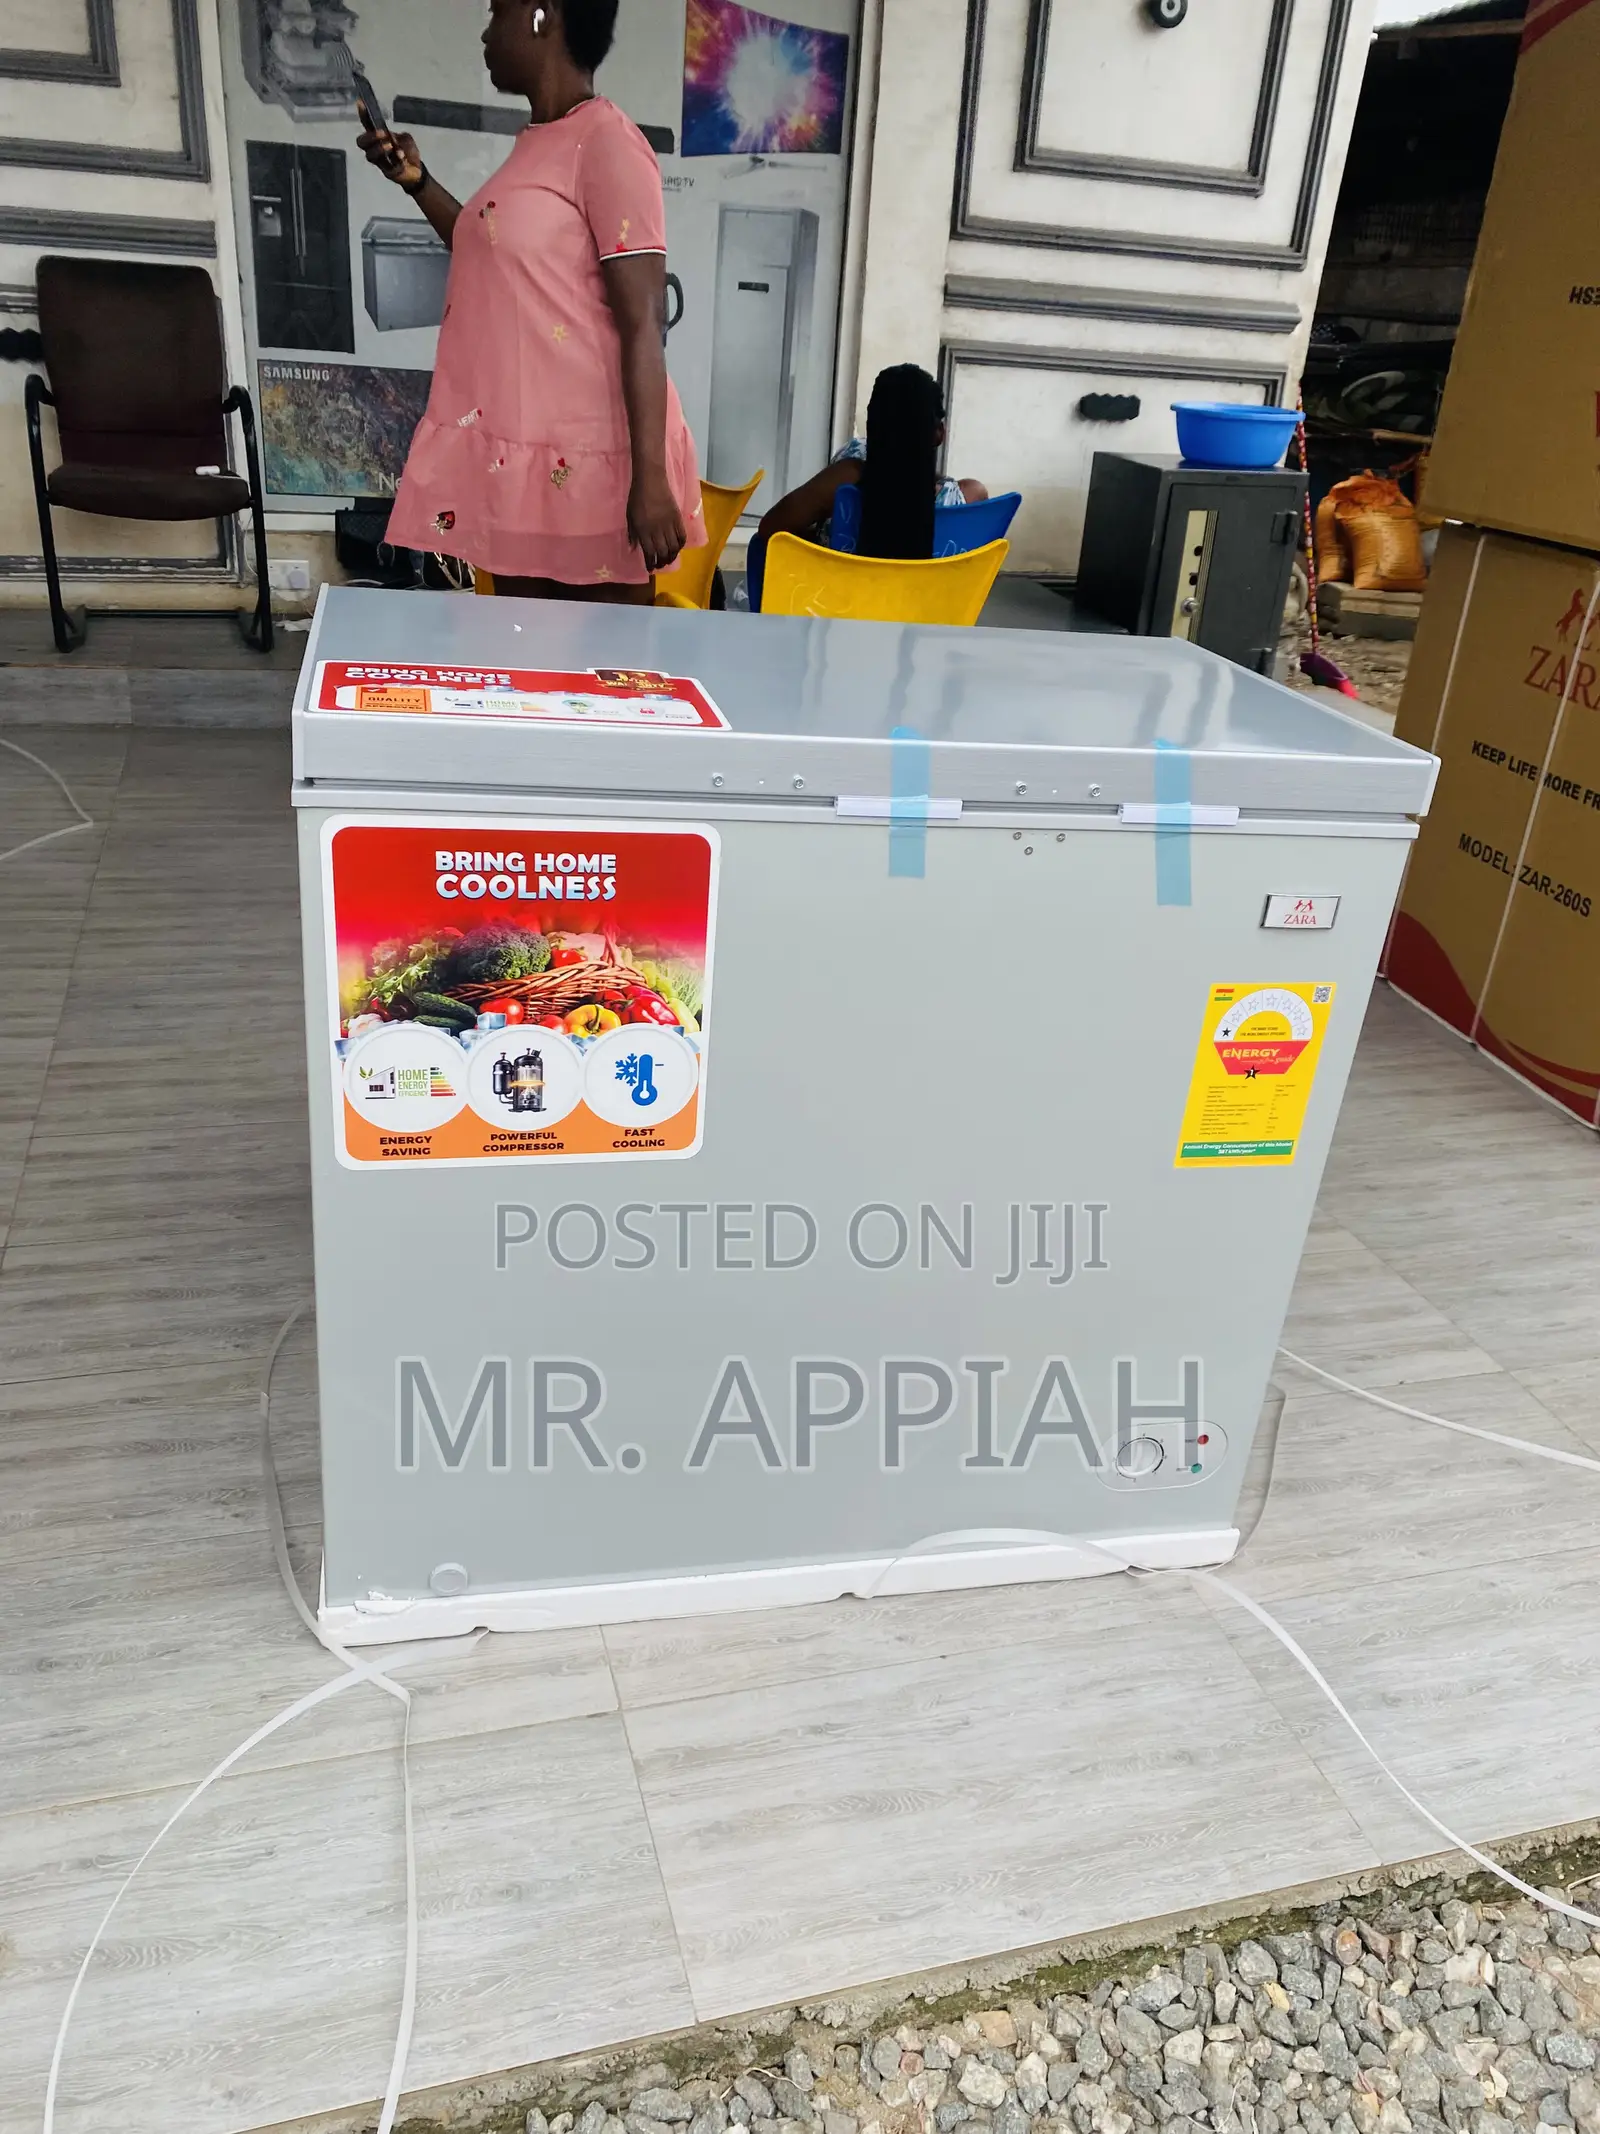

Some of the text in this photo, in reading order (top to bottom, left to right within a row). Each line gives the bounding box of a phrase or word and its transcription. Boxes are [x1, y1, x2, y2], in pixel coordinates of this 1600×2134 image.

[263, 365, 330, 381] SAMSUNG
[346, 666, 511, 679] BRING HOME
[1523, 645, 1600, 711] ZAR
[345, 673, 511, 685] COOLNESS
[1471, 740, 1507, 766] KEEP
[1507, 756, 1538, 781] LIFE
[435, 850, 617, 874] BRING HOME
[435, 873, 617, 901] COOLNESS
[1283, 913, 1317, 925] ZARA
[1222, 1047, 1280, 1060] ENERGY
[397, 1069, 428, 1081] HOME
[398, 1081, 429, 1090] ENERGY
[490, 1132, 557, 1141] POWERFUL
[624, 1128, 655, 1137] FAST
[379, 1135, 432, 1145] ENERGY
[612, 1138, 665, 1148] COOLING
[382, 1147, 431, 1156] SAVING
[482, 1142, 565, 1152] COMPRESSOR
